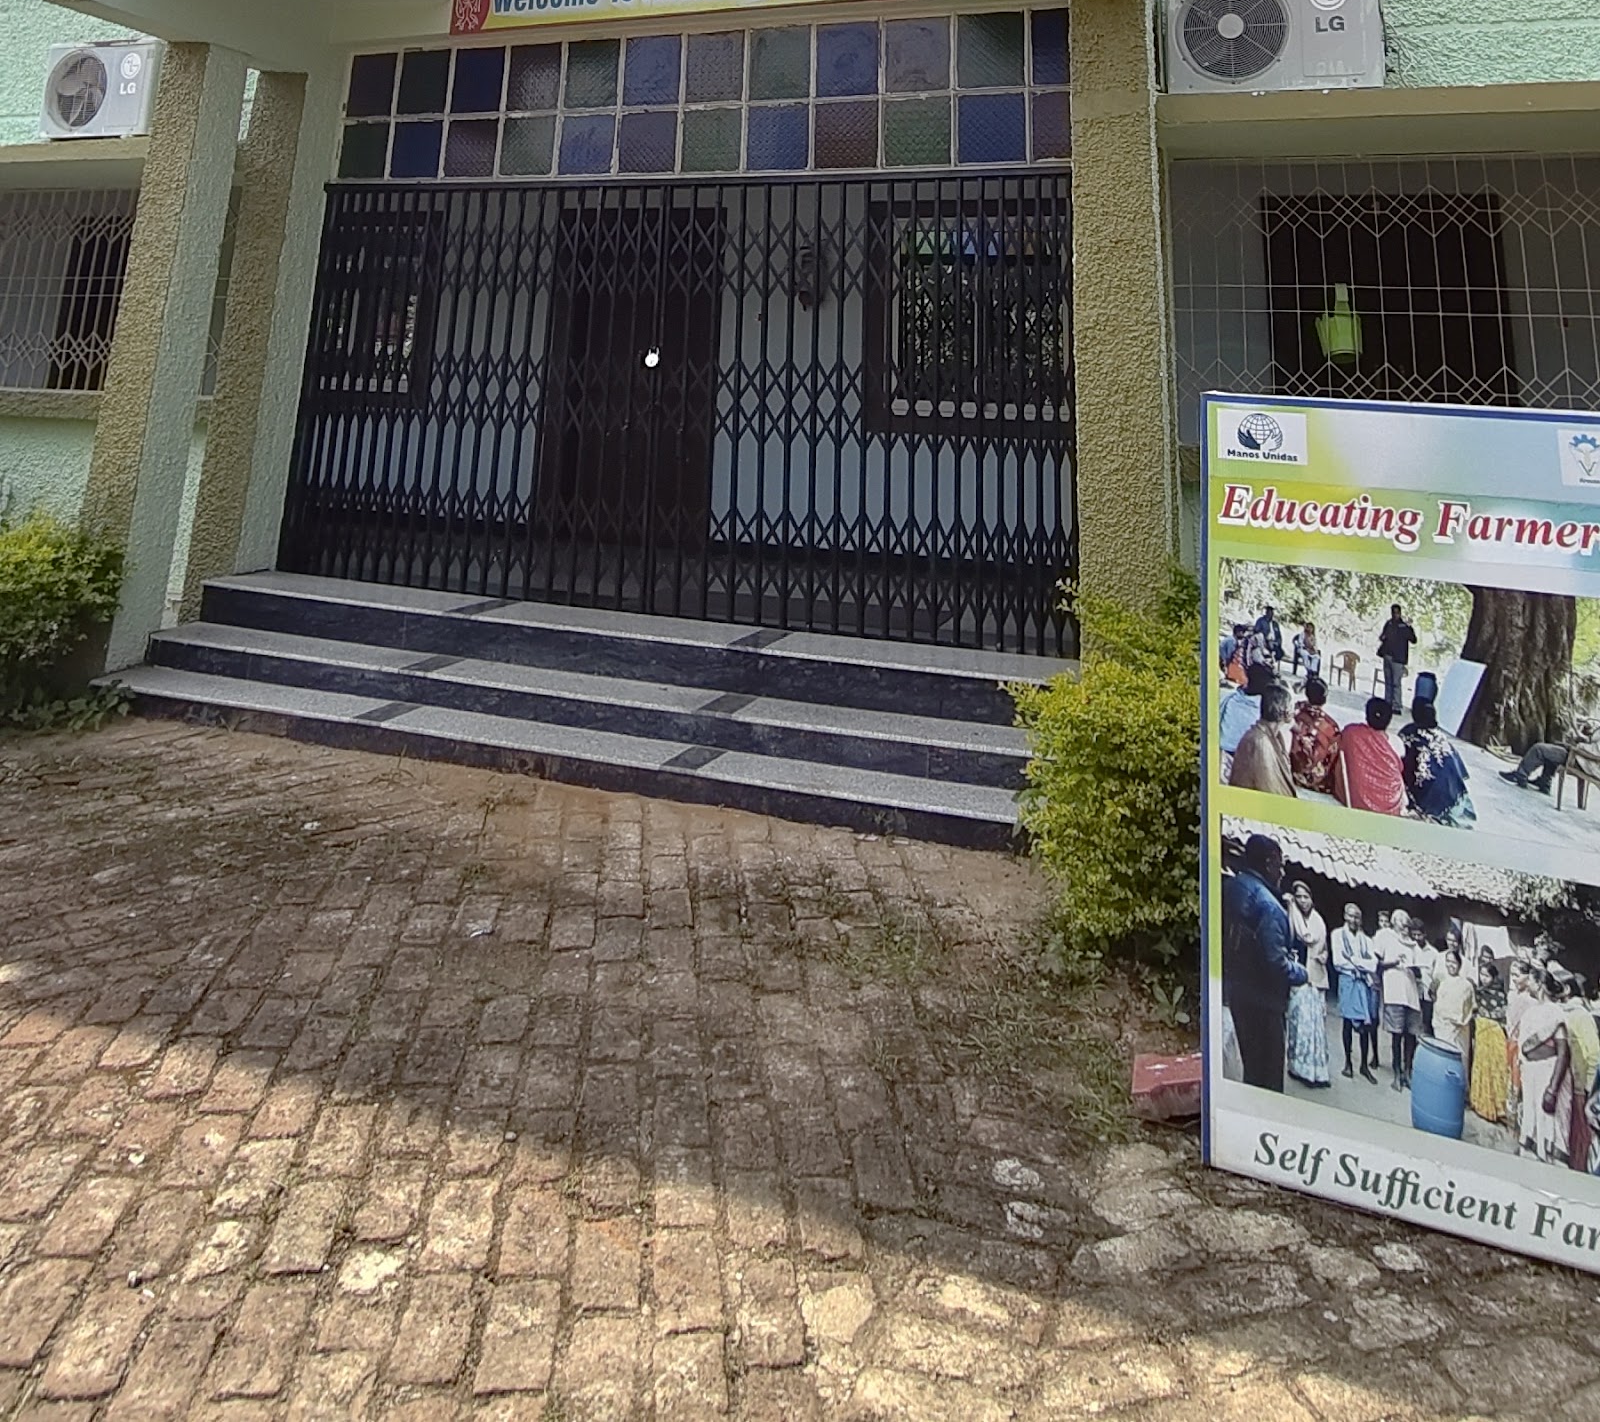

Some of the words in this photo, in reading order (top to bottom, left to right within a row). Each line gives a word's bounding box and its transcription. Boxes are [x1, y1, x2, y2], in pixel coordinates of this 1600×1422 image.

[1315, 15, 1345, 33] LG
[120, 82, 136, 95] LG
[1227, 448, 1260, 459] Manos
[1262, 451, 1298, 462] Unidas
[1219, 484, 1421, 547] Educating
[1434, 501, 1600, 551] Farmer
[1253, 1131, 1331, 1186] Self
[1333, 1152, 1518, 1231] Sufficient
